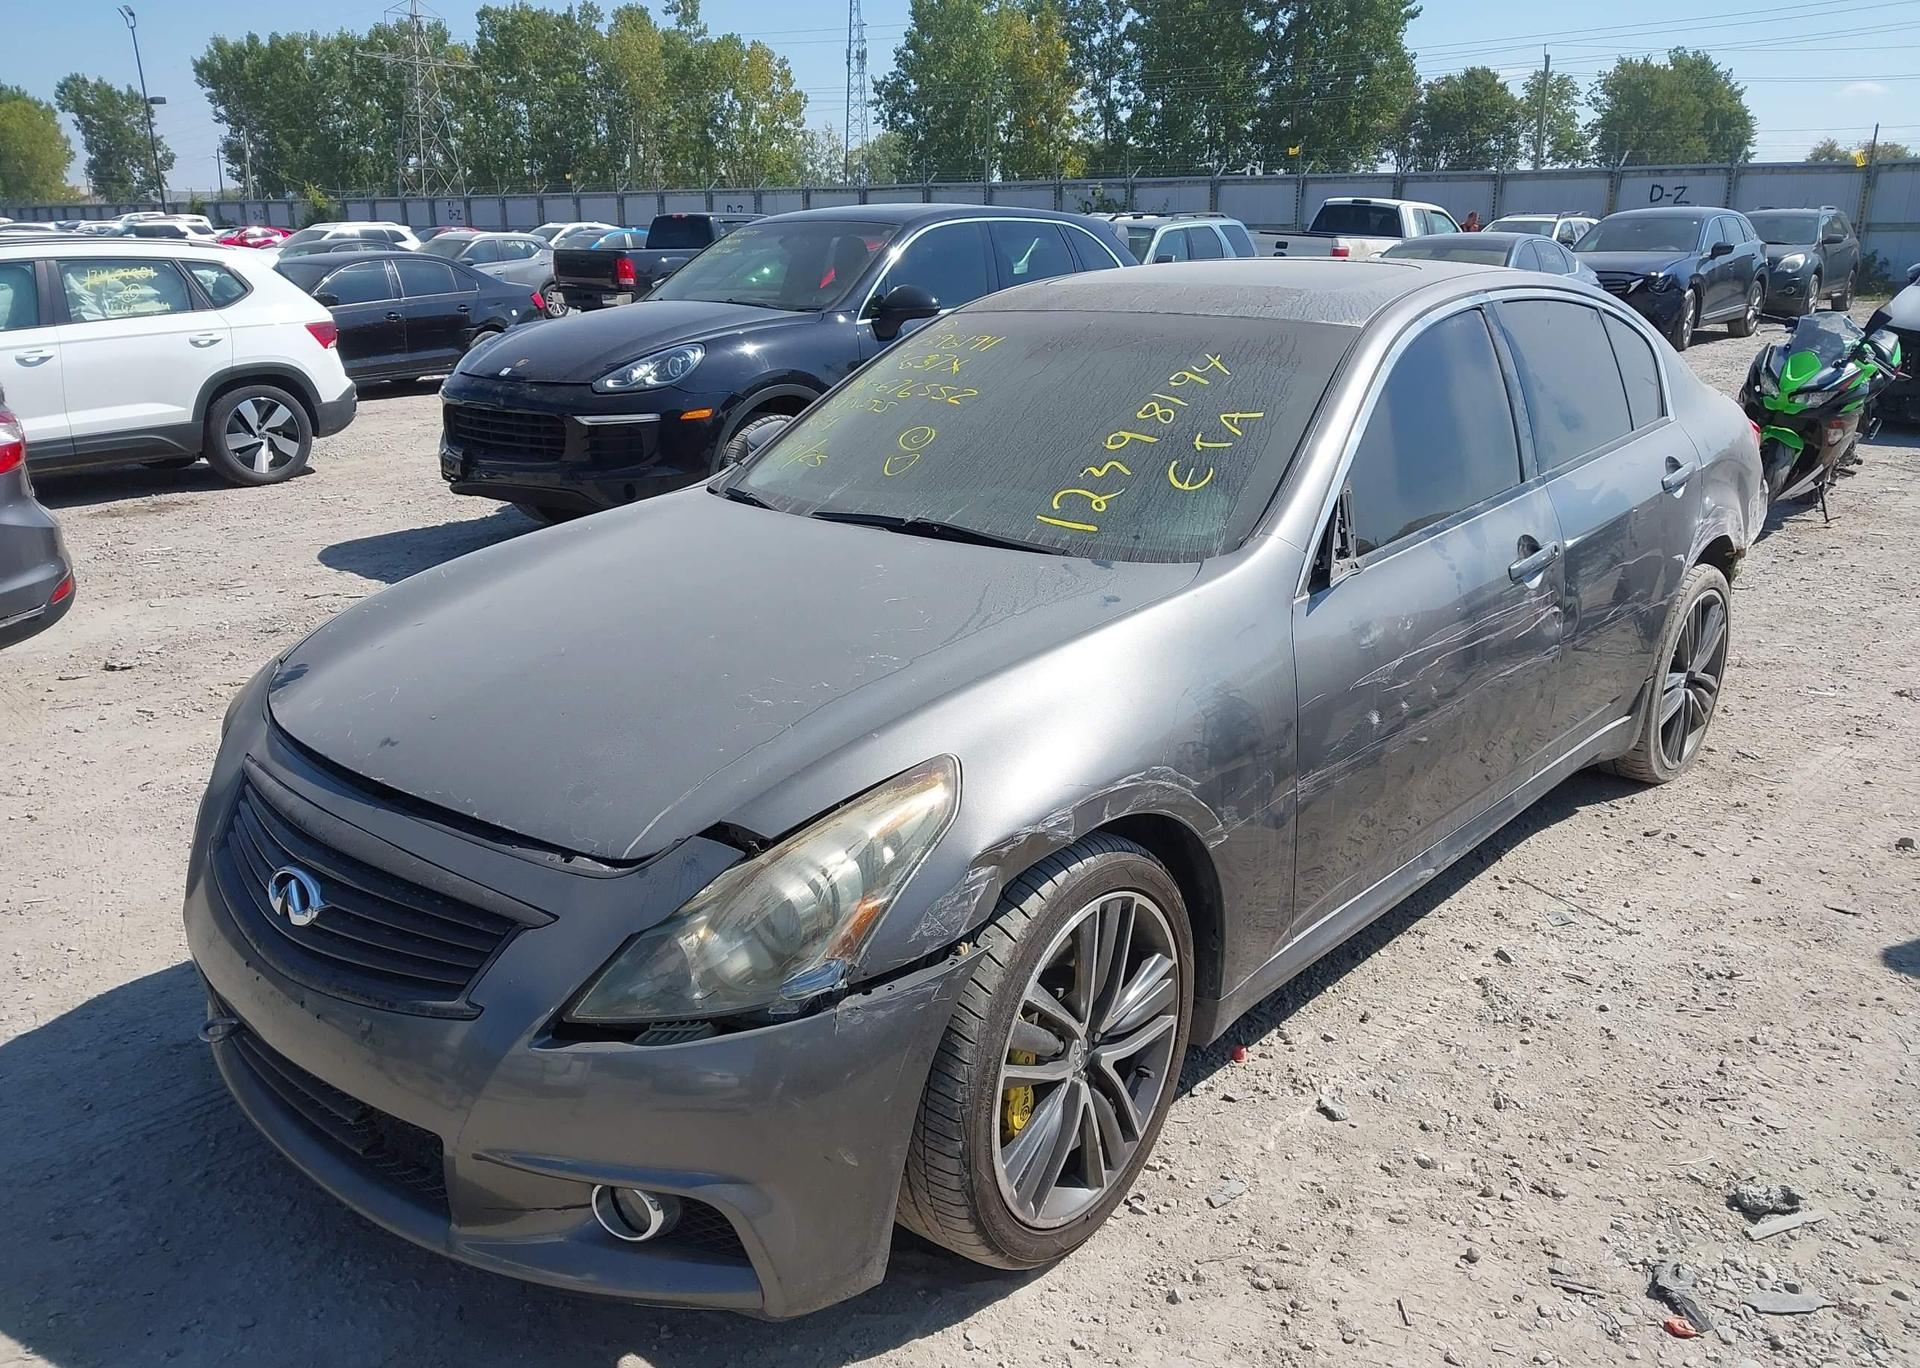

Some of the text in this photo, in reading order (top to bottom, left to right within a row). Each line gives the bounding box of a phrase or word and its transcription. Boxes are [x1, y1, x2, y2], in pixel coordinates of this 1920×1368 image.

[1650, 184, 1690, 204] D-Z
[1037, 354, 1231, 532] 12398194
[1168, 412, 1264, 491] ETA
